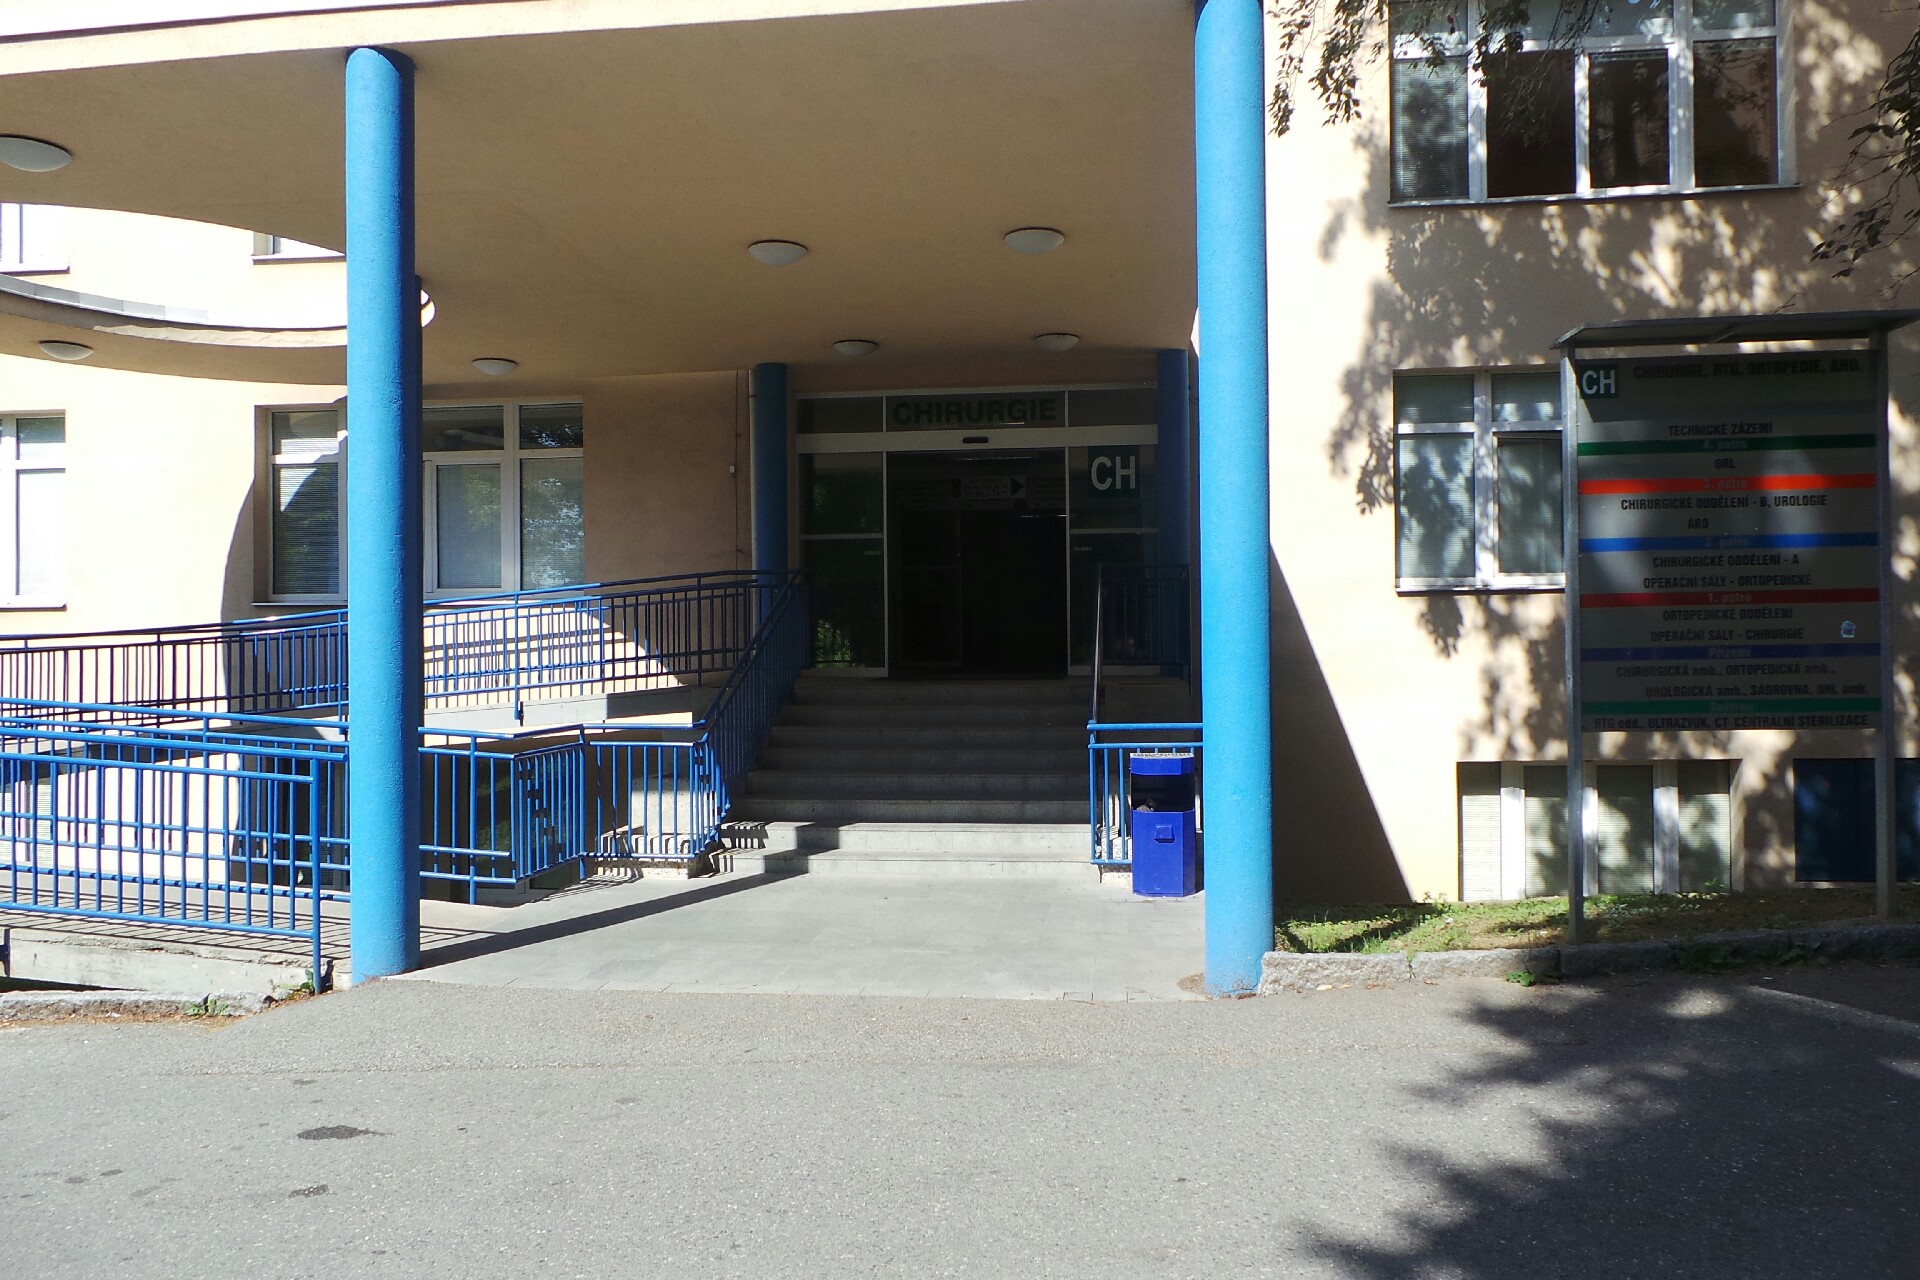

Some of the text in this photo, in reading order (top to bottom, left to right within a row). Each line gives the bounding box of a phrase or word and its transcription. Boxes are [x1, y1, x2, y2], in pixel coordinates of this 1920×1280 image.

[1748, 360, 1828, 377] ORTOPEDIE,
[1582, 369, 1616, 395] CH
[893, 399, 1057, 425] CHIRURGIE
[1668, 421, 1773, 437] TECHNICKÉ ZÁZEMÍ
[1714, 458, 1736, 470] ORL
[1090, 455, 1136, 491] CH
[1703, 478, 1748, 491] 3. patro
[1621, 496, 1693, 510] CHIRURGICKÉ
[1696, 494, 1749, 509] ODDĚLENÍ
[1774, 494, 1828, 507] UROLOGIE
[1687, 518, 1709, 530] ARO
[1719, 535, 1749, 548] patro
[1652, 554, 1723, 568] CHIRURGICKÉ
[1728, 552, 1781, 567] ODDĚLENÍ
[1792, 553, 1800, 566] A
[1643, 574, 1698, 589] OPERAČNÍ
[1700, 573, 1727, 588] SÁLY
[1738, 571, 1812, 587] ORTOPEDICKÉ
[1707, 592, 1752, 605] 1. patro
[1663, 605, 1793, 621] ORTOPEDICKÉ ODDĚLENÍ
[1651, 628, 1705, 642] OPERAČNÍ
[1708, 627, 1734, 641] SÁLY
[1745, 626, 1805, 641] CHIRURGIE
[1616, 665, 1689, 678] CHIRURGICKÁ
[1726, 661, 1800, 676] ORTOPEDICKÁ
[1646, 684, 1713, 697] UROLOGICKÁ
[1797, 714, 1869, 728] STERILIZACE
